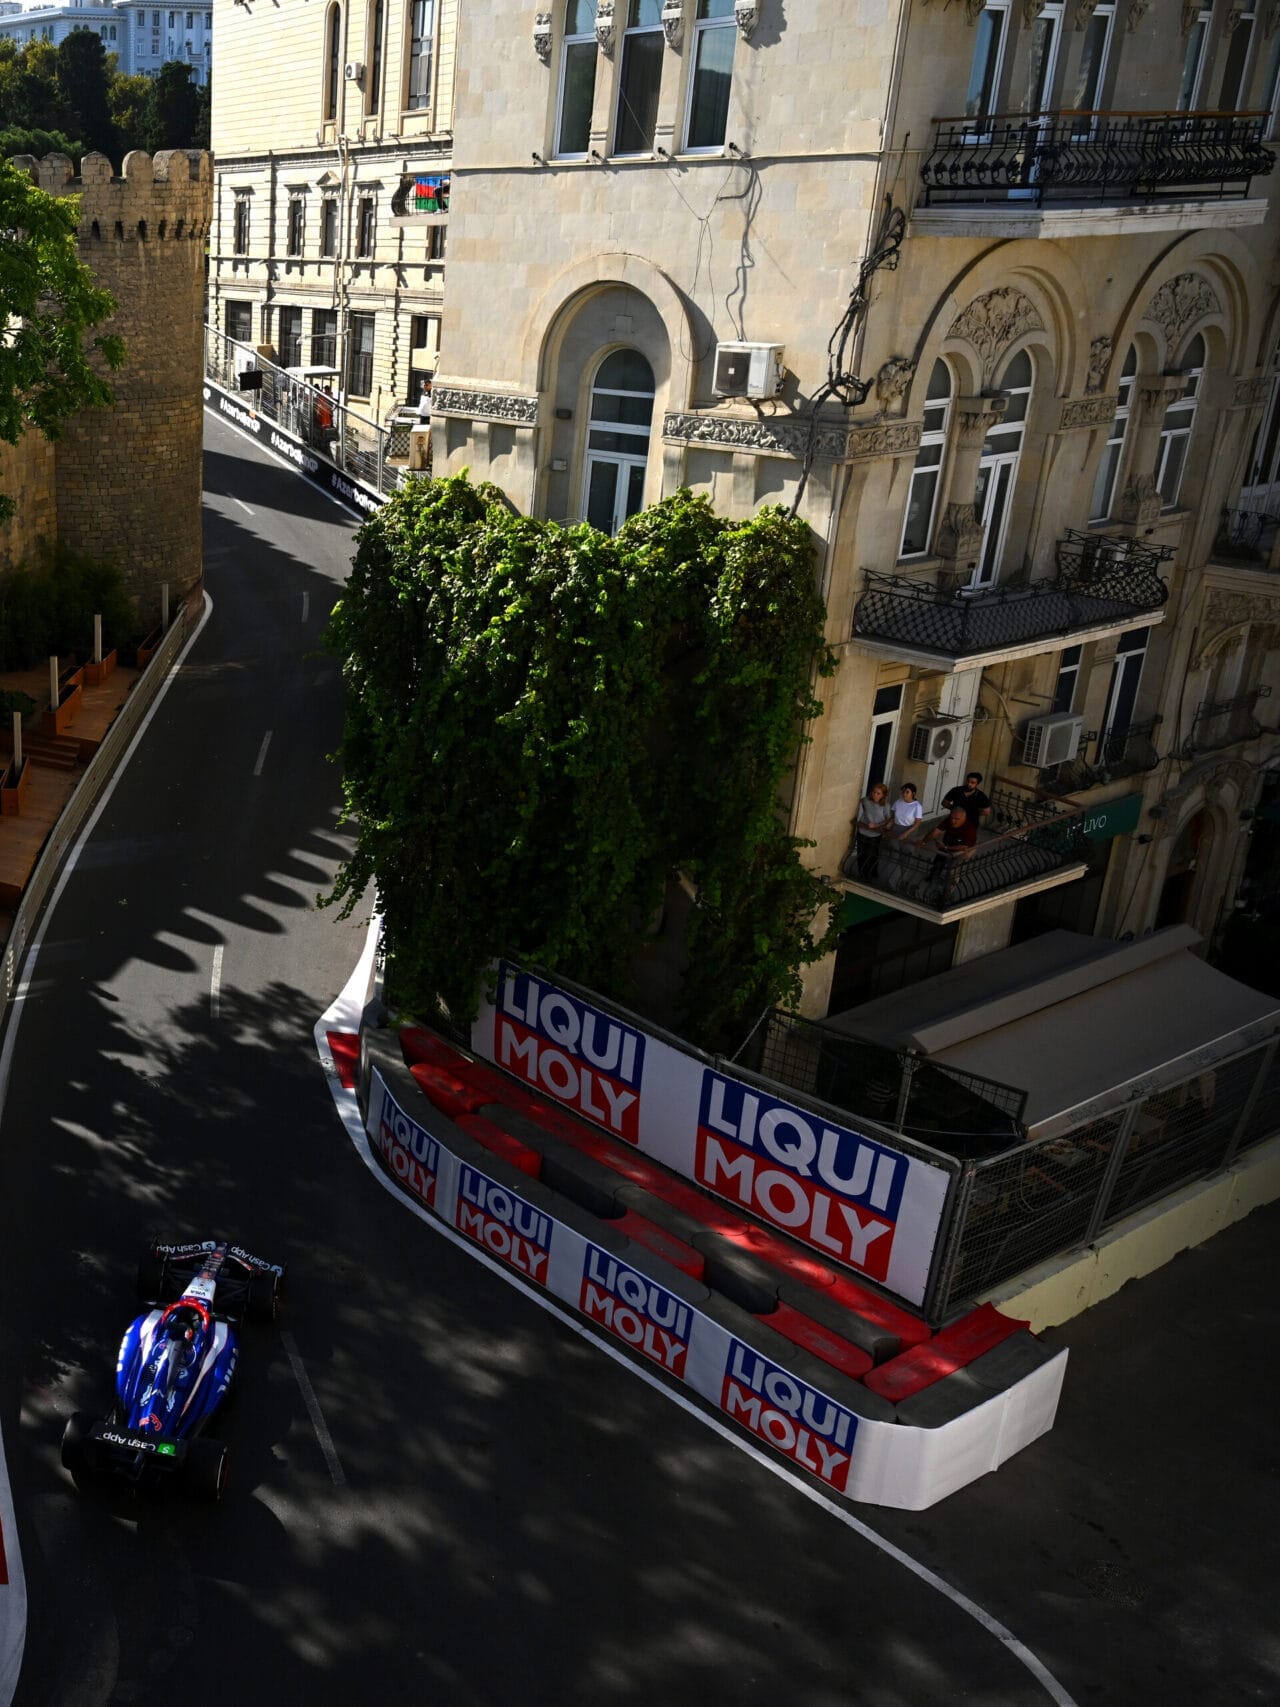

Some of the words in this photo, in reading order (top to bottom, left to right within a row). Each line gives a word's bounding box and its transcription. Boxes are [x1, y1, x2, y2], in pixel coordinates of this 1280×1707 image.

[503, 971, 642, 1082] LIQUI
[500, 1018, 637, 1131] MOLY
[380, 1126, 435, 1200] MOLY
[382, 1101, 436, 1168] LIQUI
[708, 1079, 897, 1212] LIQUI
[460, 1203, 547, 1278] MOLY
[462, 1168, 548, 1248] LIQUI
[704, 1136, 891, 1267] MOLY
[585, 1287, 686, 1372] MOLY
[588, 1249, 689, 1338] LIQUI
[103, 1432, 126, 1444] App
[727, 1383, 848, 1481] MOLY
[731, 1346, 851, 1447] LIQUI
[128, 1439, 156, 1451] Cash
